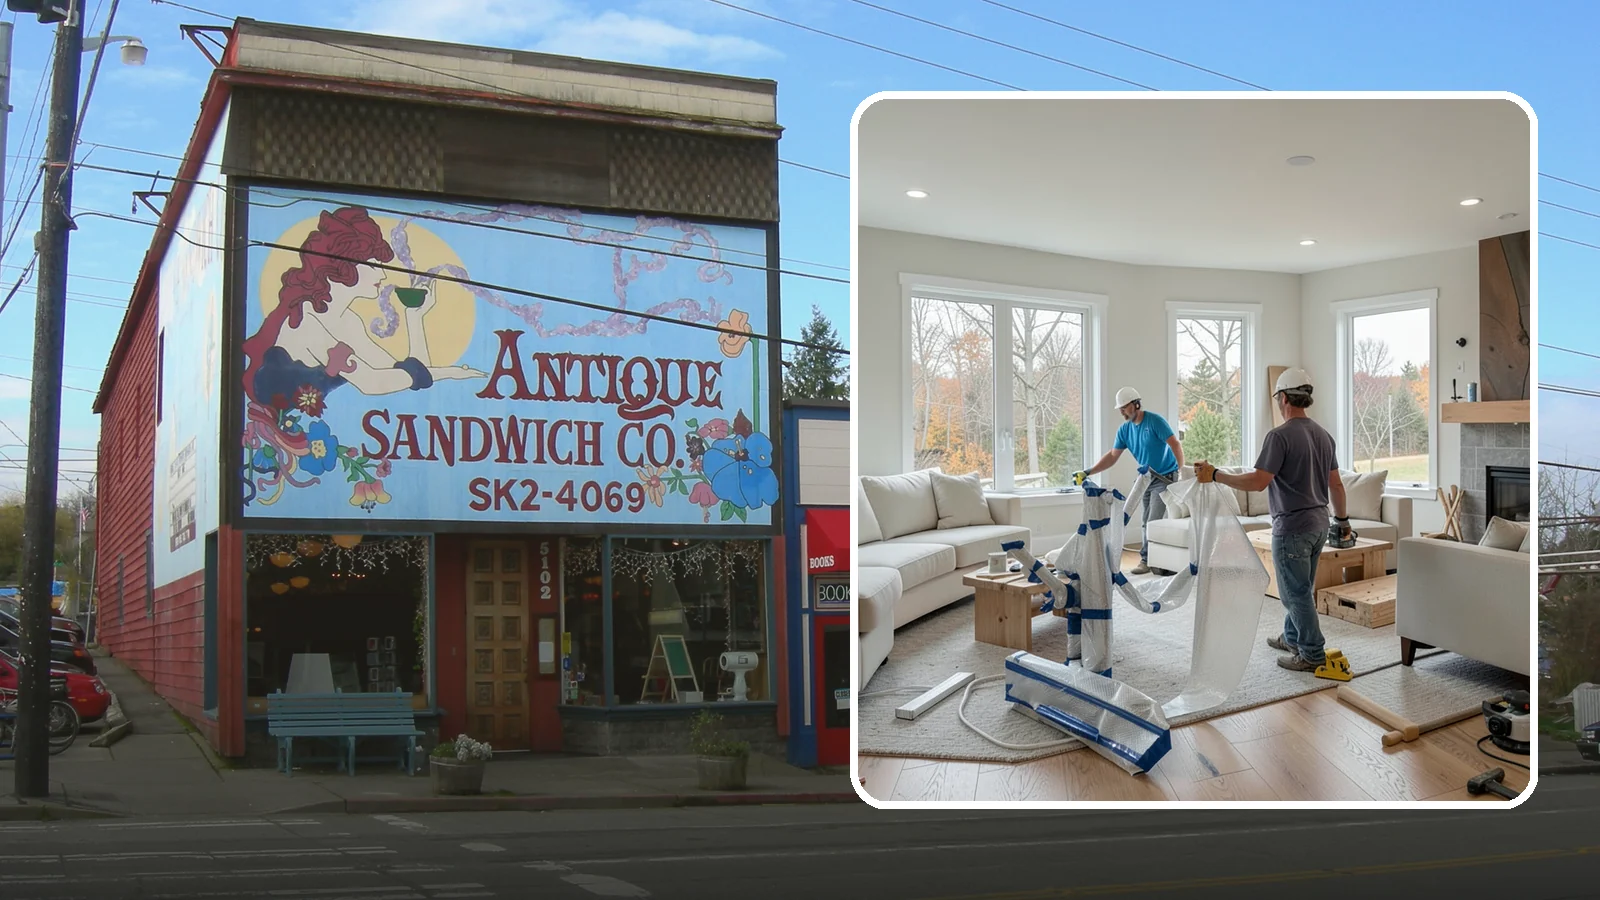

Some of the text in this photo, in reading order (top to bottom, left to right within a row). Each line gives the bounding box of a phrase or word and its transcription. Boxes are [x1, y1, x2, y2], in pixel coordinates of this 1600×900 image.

[475, 329, 724, 421] ANTIQUE
[361, 409, 685, 467] SANDWICH CO.
[468, 477, 645, 512] SK2-4069
[539, 541, 551, 600] 5102
[809, 555, 835, 569] BOOKS
